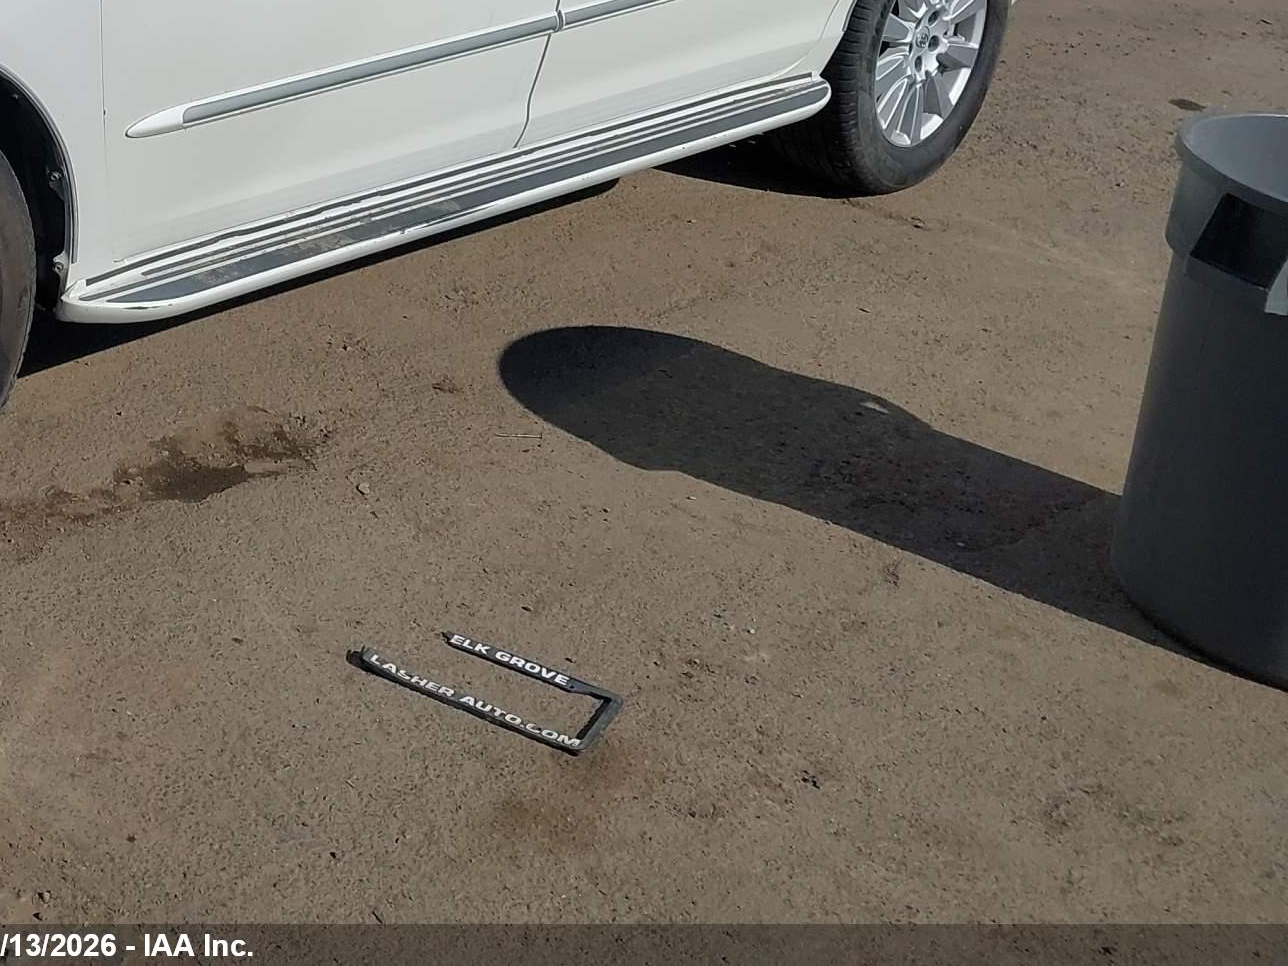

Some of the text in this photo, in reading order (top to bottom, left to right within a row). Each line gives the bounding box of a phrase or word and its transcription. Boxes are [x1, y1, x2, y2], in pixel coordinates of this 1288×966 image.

[449, 634, 570, 686] ELK GROVE
[370, 654, 582, 748] LASHER AUTO.COM
